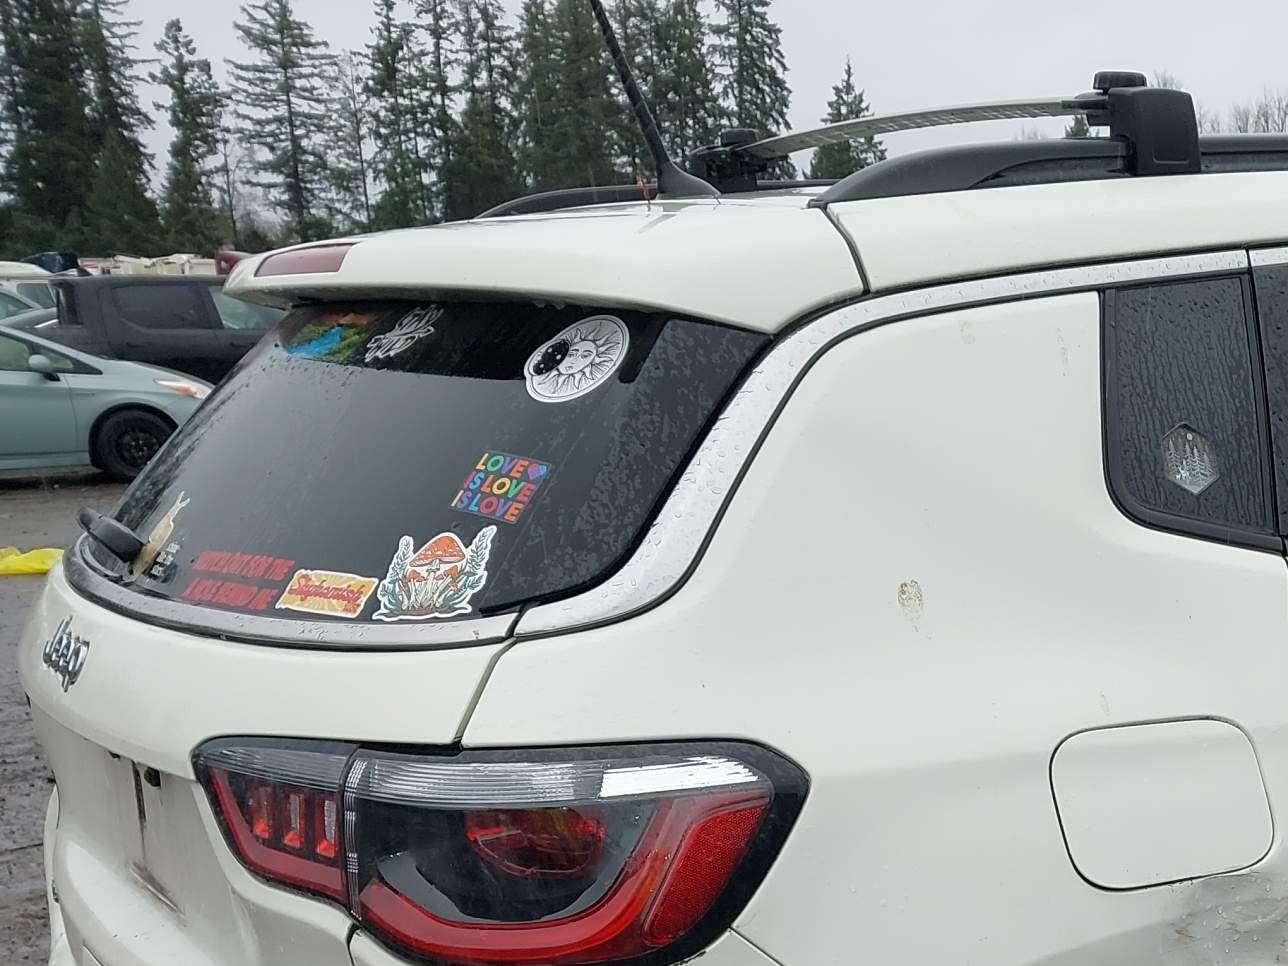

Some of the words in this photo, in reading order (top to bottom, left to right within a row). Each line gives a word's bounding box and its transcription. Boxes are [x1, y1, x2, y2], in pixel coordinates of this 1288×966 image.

[475, 453, 529, 479] LOVE
[463, 471, 486, 490] IS
[480, 474, 537, 503] LOVE
[450, 489, 473, 509] IS
[468, 493, 525, 521] LOVE
[43, 616, 90, 692] Jeep
